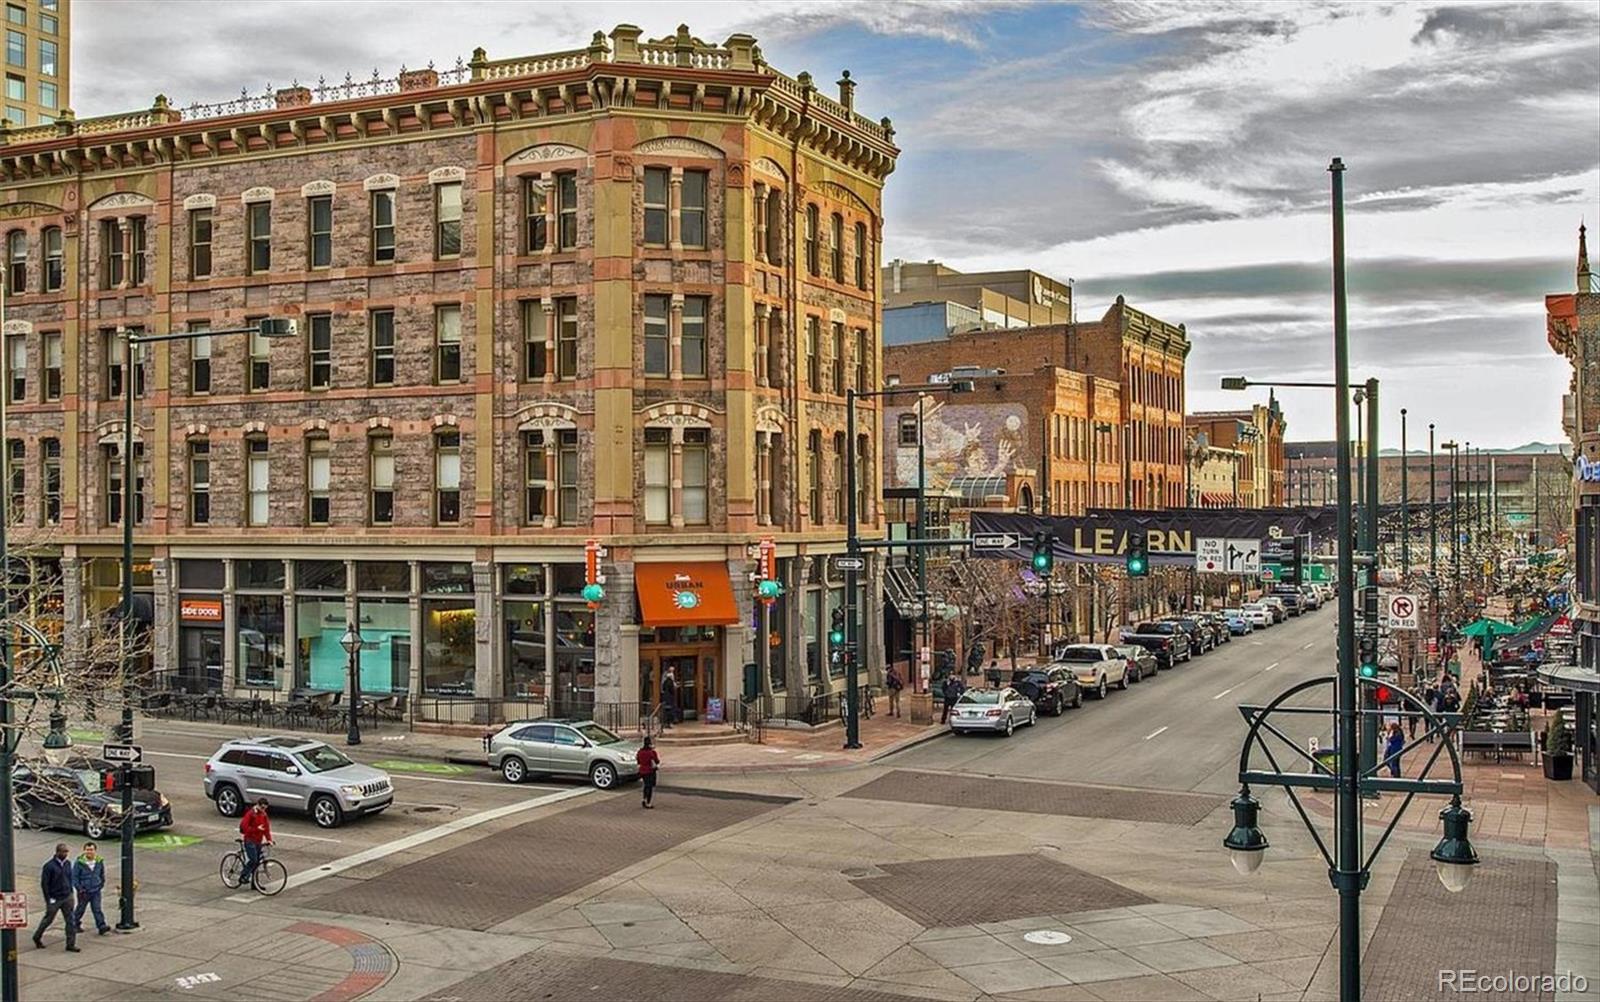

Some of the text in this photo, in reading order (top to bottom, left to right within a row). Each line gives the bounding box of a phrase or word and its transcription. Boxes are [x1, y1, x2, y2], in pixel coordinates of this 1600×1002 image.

[665, 581, 703, 589] URBAN
[181, 607, 219, 616] SIDE DOOR
